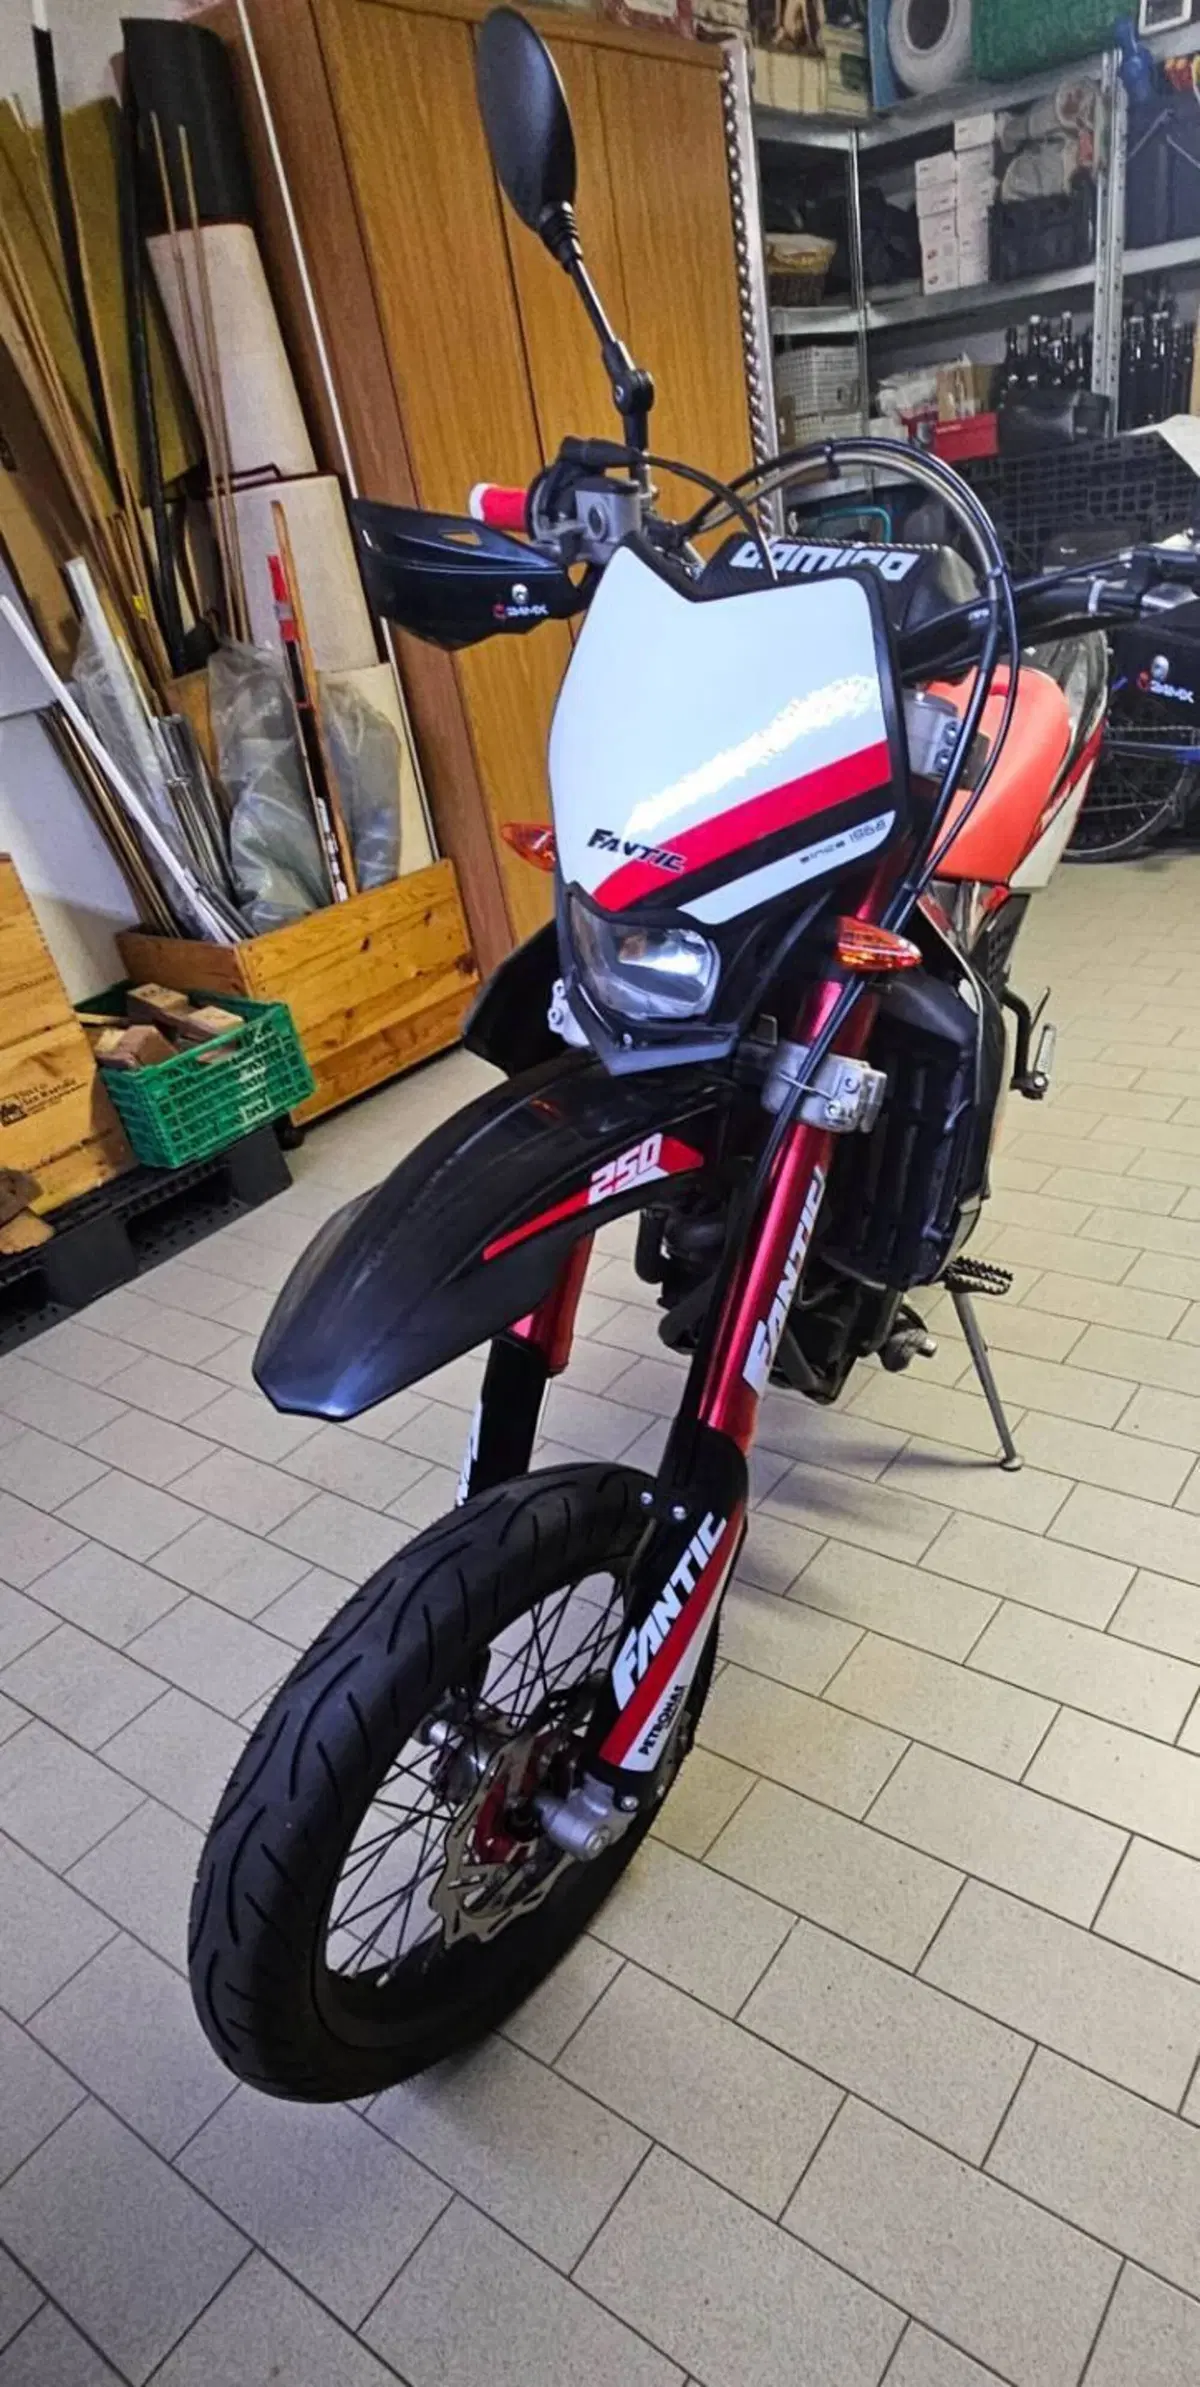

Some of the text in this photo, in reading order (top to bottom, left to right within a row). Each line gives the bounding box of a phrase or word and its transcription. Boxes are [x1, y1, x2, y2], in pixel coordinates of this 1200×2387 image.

[587, 828, 685, 873] FANTIC
[588, 1133, 663, 1205] 250
[742, 1164, 826, 1400] FANTIC
[611, 1511, 727, 1711] FANTIC
[638, 1685, 684, 1756] PETRONAS
